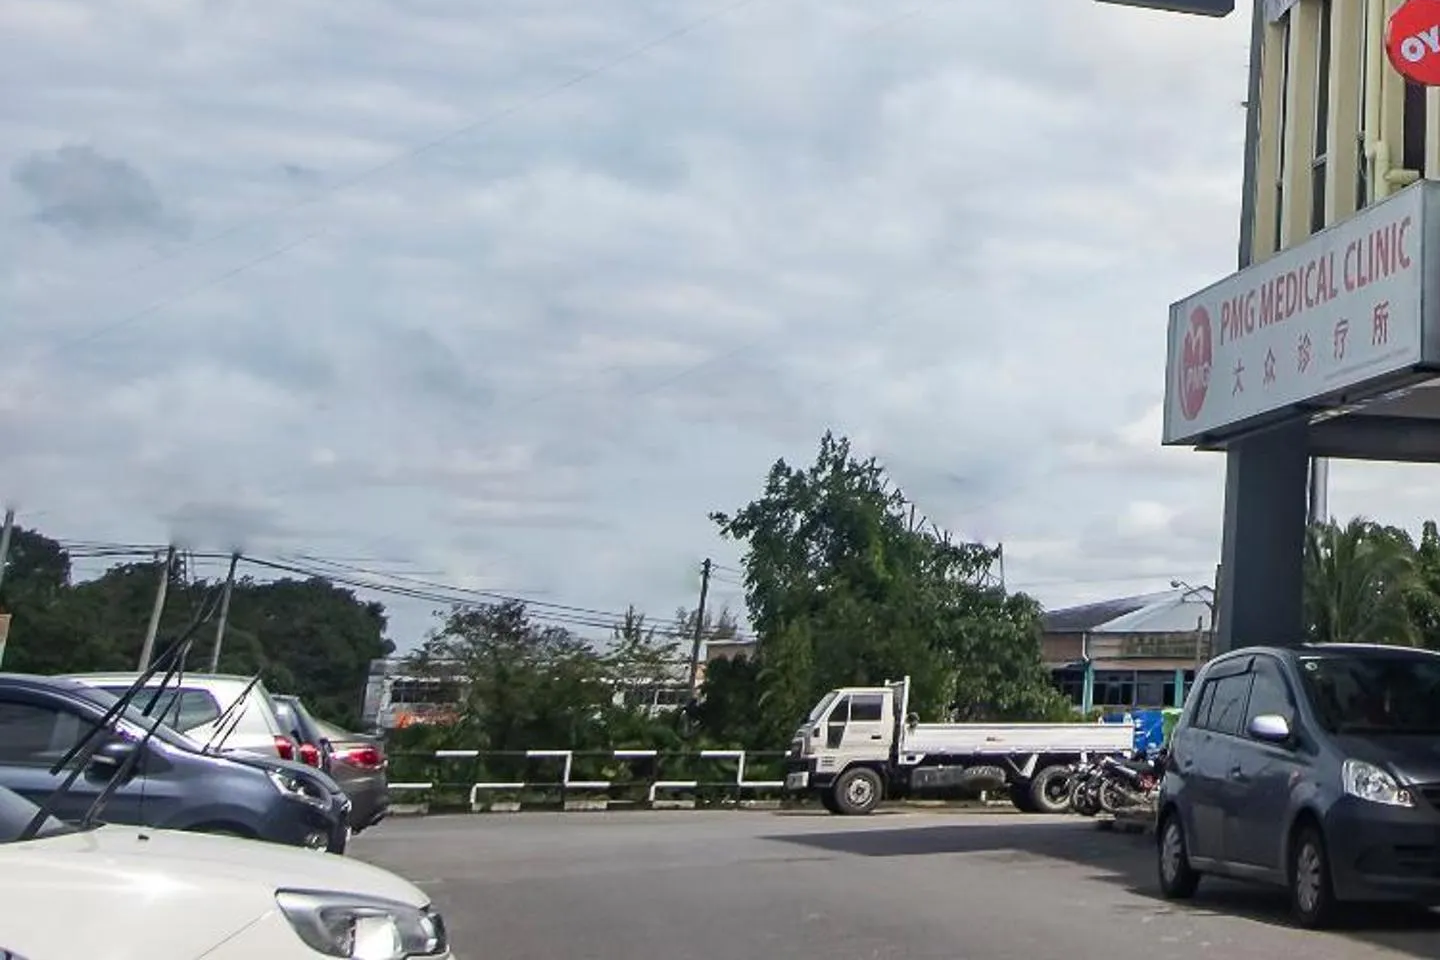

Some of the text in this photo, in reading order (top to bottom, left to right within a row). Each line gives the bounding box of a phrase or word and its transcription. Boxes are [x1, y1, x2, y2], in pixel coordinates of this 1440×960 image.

[1220, 215, 1411, 346] PMG MEDICAL CLINIC
[1231, 300, 1390, 398] 大众诊疗所
